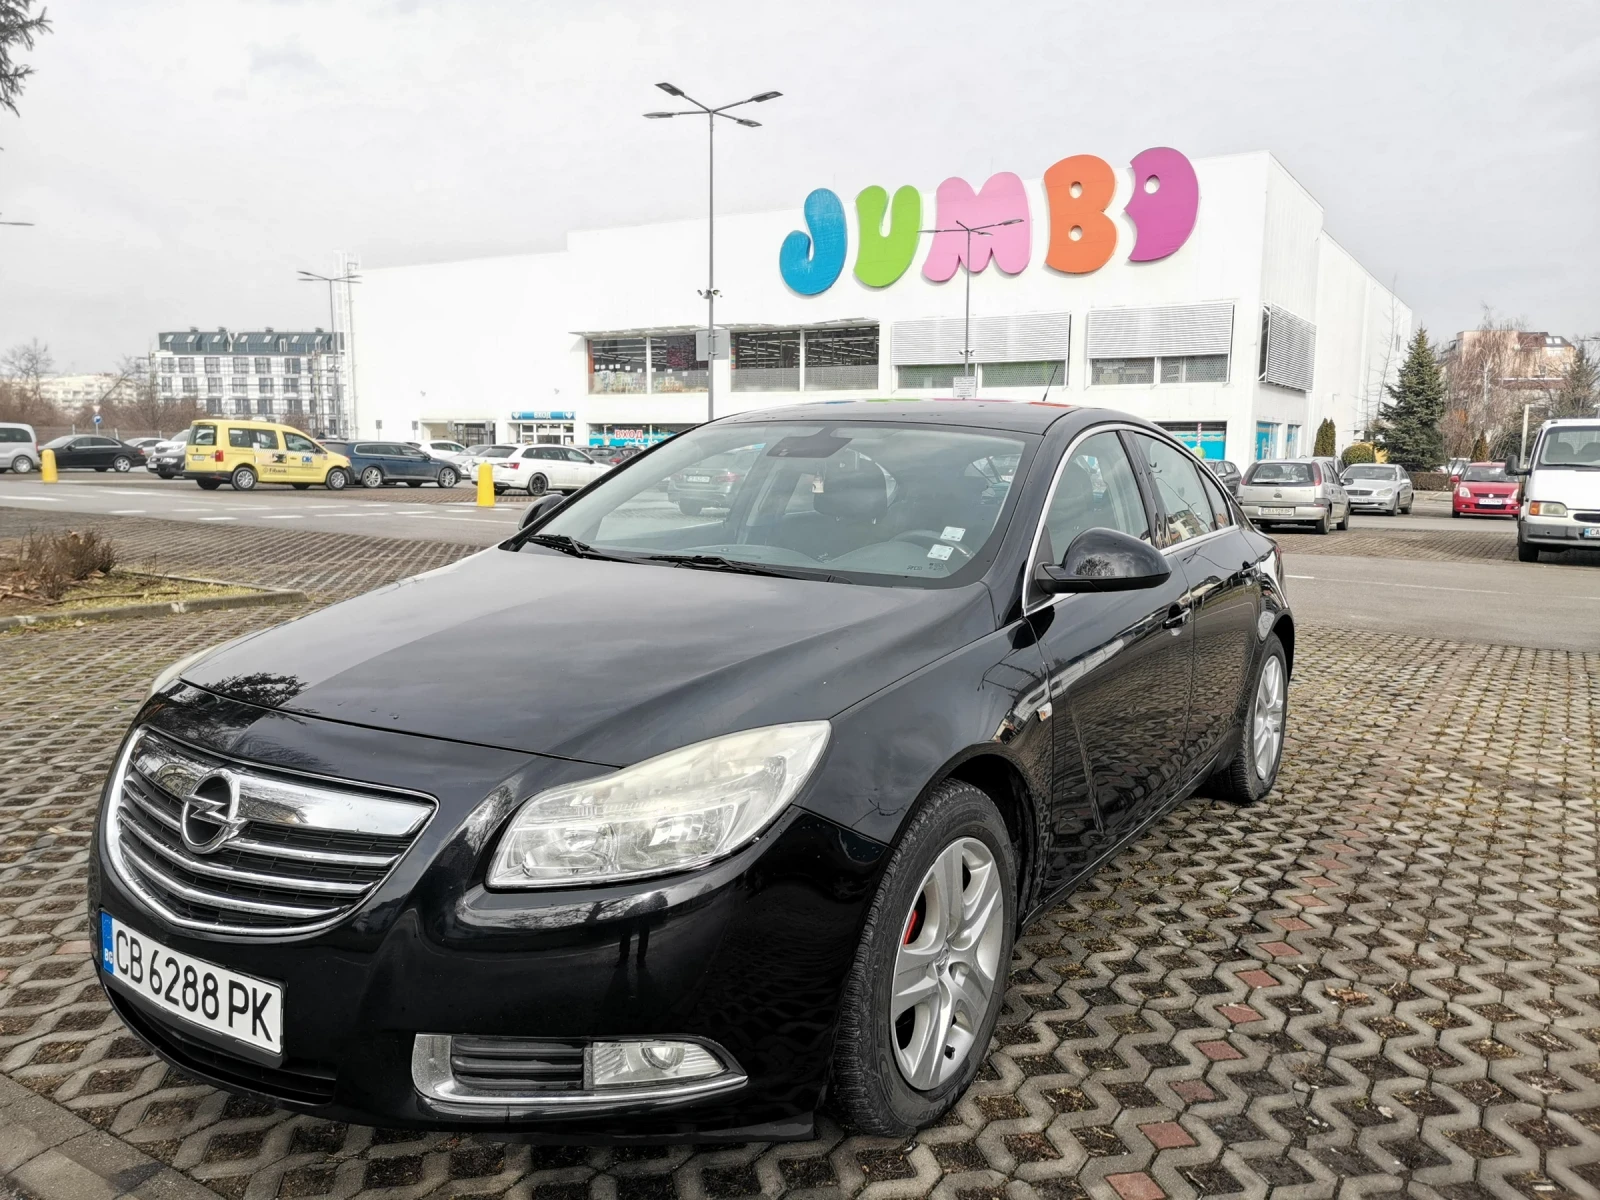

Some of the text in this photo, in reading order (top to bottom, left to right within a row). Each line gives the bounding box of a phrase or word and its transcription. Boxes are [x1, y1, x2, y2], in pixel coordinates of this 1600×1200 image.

[779, 146, 1199, 296] JUMBO
[533, 411, 551, 420] ВХОД
[615, 429, 643, 440] ВХОД
[104, 947, 114, 965] BG
[115, 929, 273, 1043] CB 6288 PK
